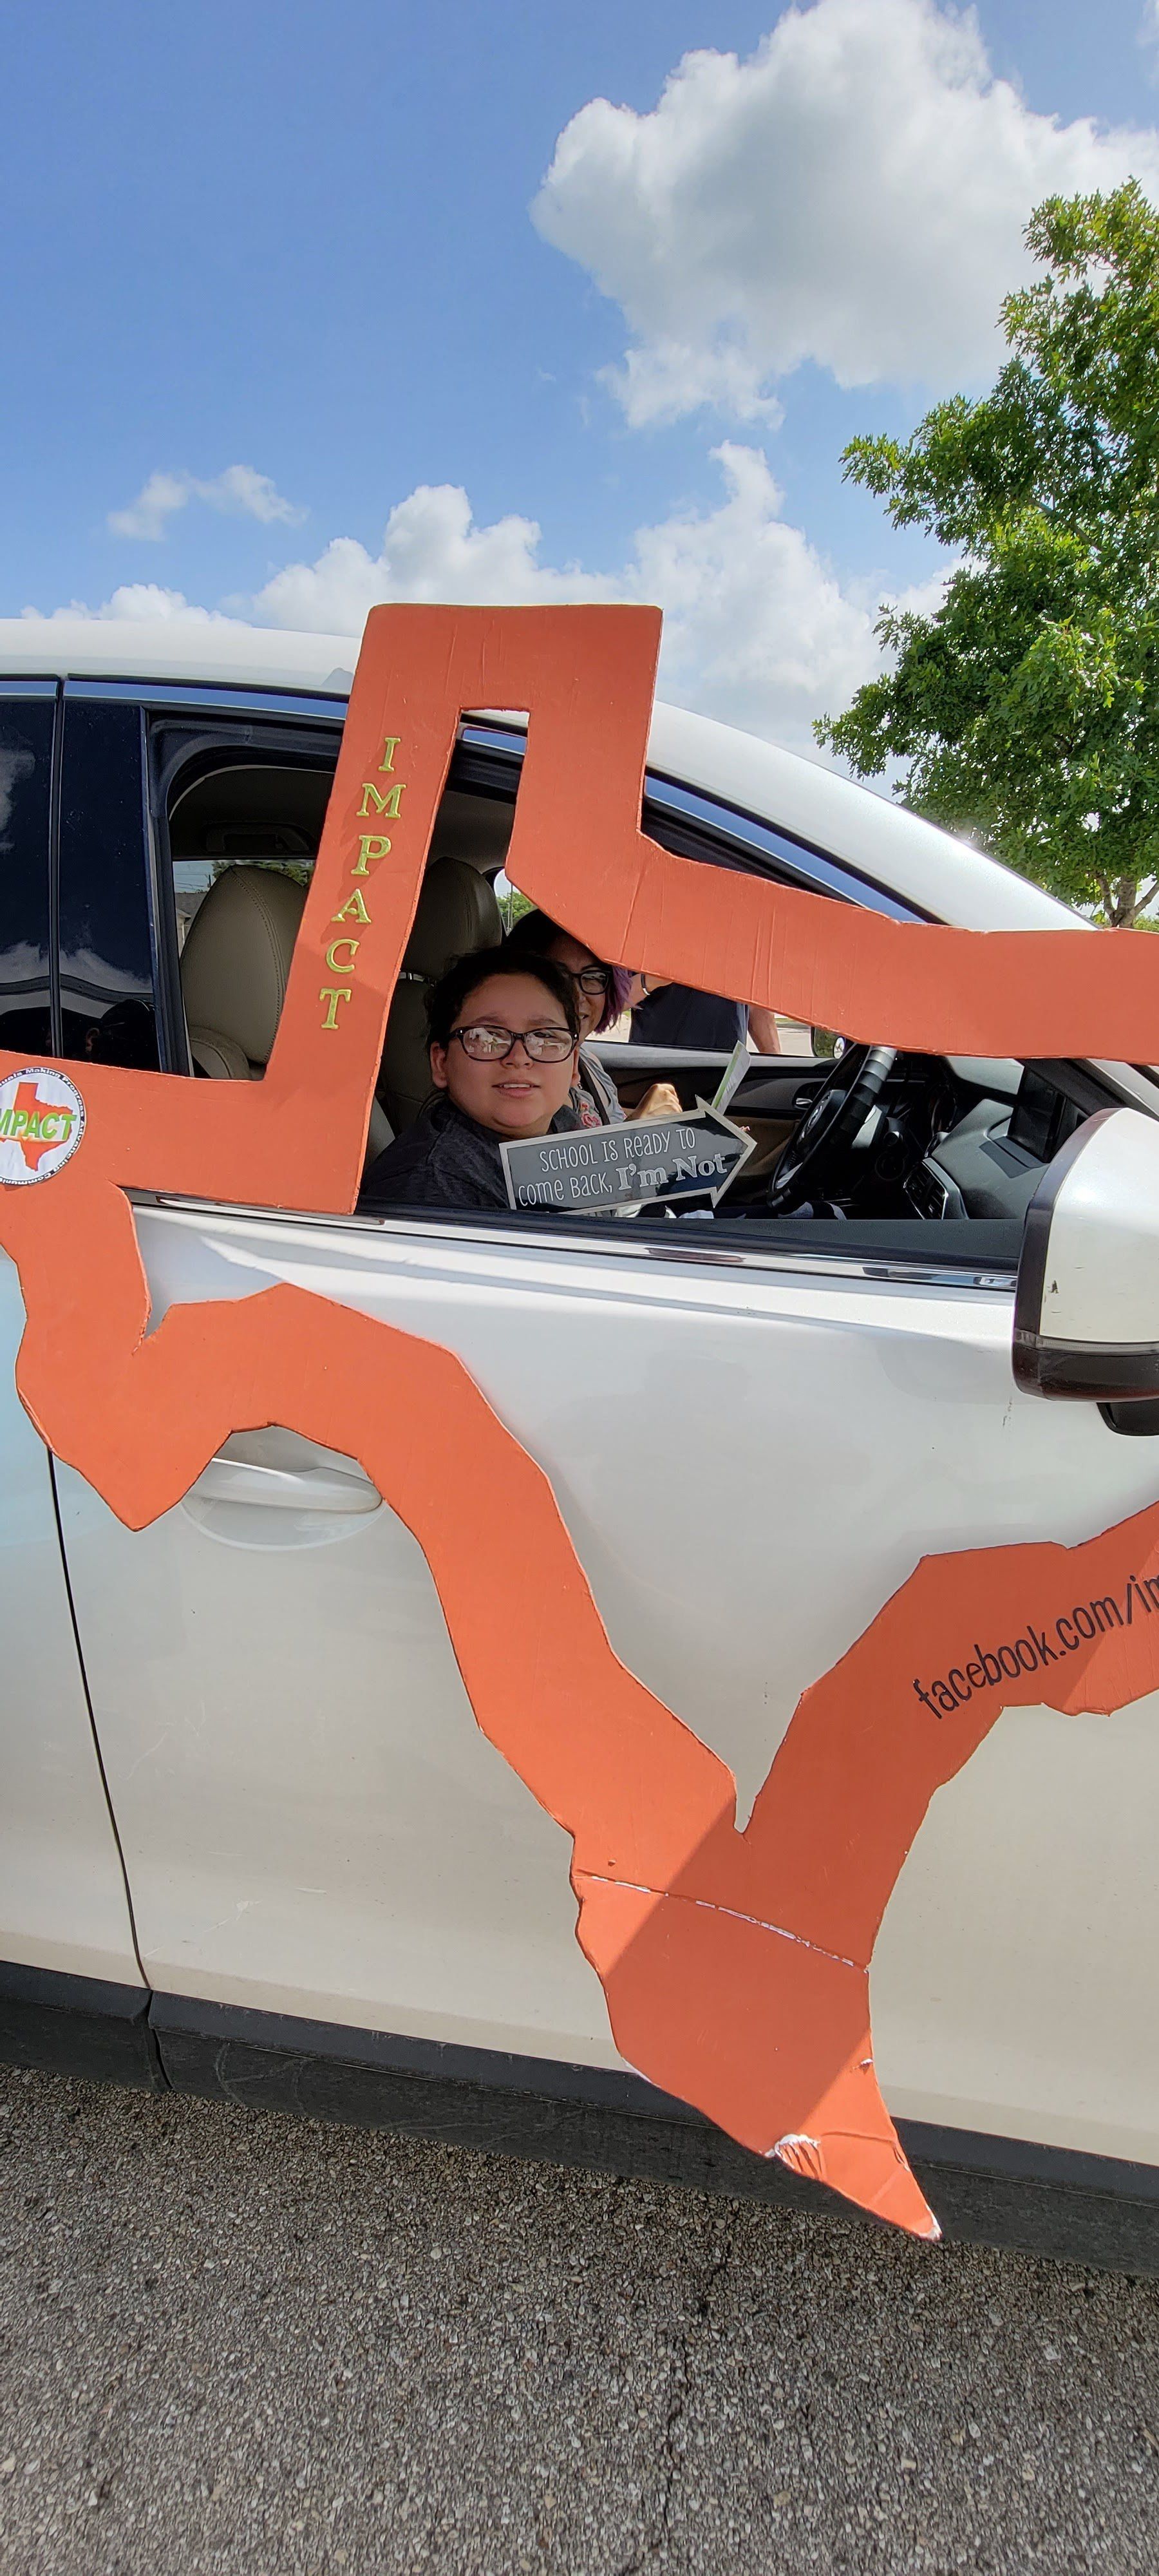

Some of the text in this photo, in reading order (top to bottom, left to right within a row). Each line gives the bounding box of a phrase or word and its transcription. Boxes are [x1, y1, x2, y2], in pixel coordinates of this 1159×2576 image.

[319, 737, 406, 1030] IMPACT
[0, 1072, 23, 1086] uals
[26, 1068, 61, 1079] Making
[62, 1077, 84, 1117] Progress
[53, 1121, 84, 1172] Advancing
[540, 1143, 598, 1172] SCHOOL
[601, 1140, 618, 1162] IS
[676, 1128, 695, 1149] TO
[616, 1162, 668, 1191] I'm
[672, 1153, 728, 1181] Not
